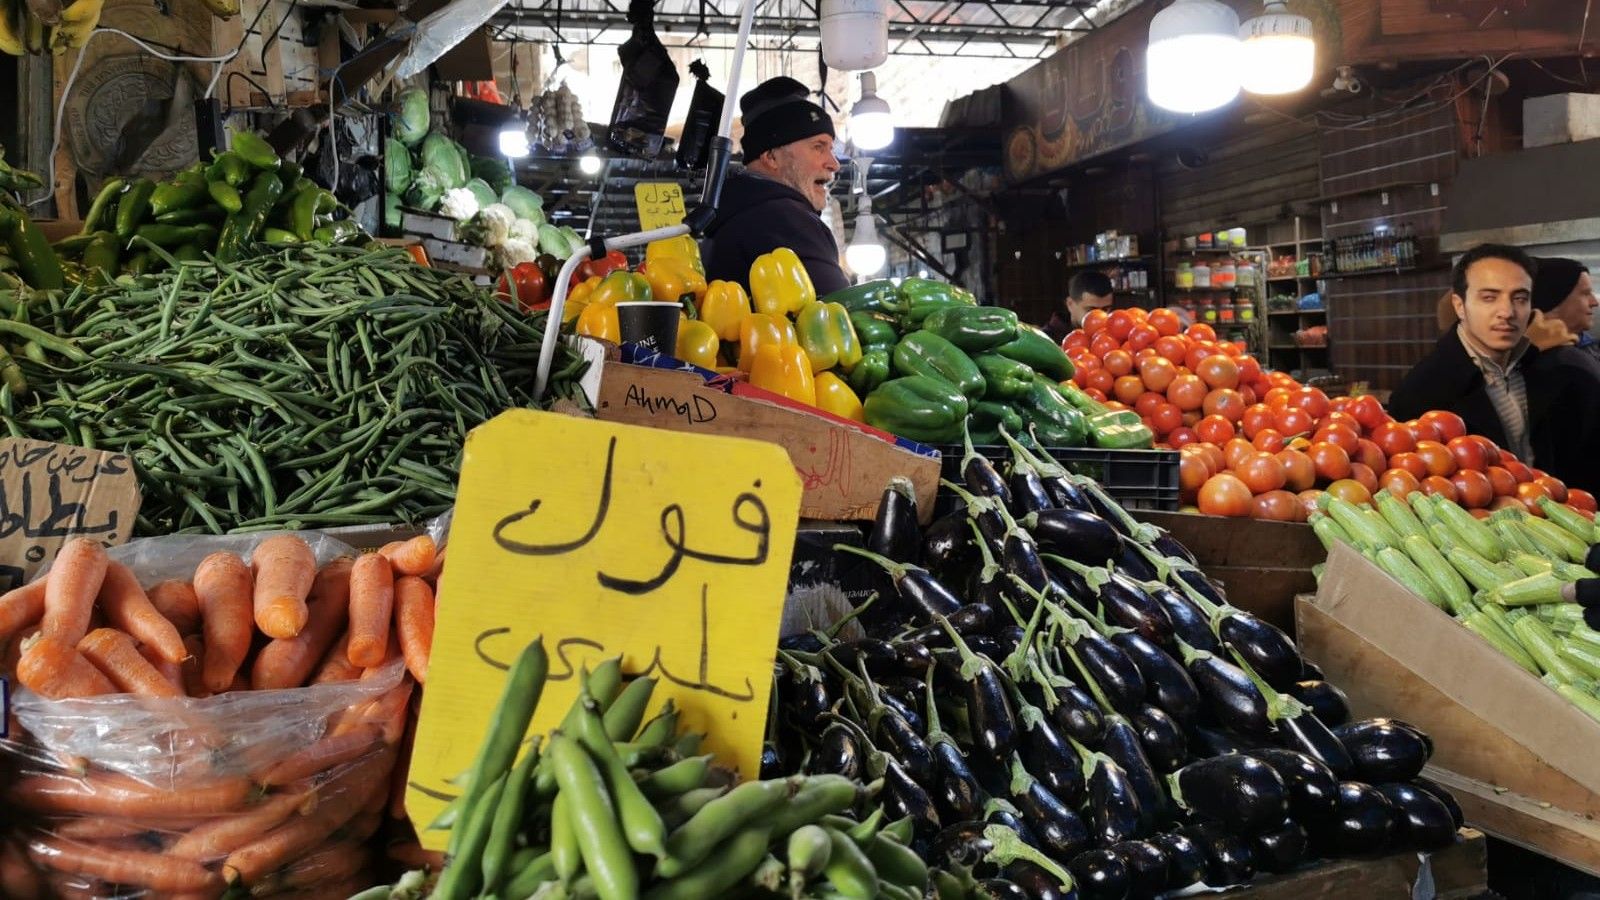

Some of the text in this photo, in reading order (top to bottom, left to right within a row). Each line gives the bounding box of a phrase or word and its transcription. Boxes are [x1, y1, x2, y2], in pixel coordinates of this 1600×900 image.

[644, 184, 680, 204] فول
[47, 449, 128, 483] عرض
[493, 436, 771, 595] فول
